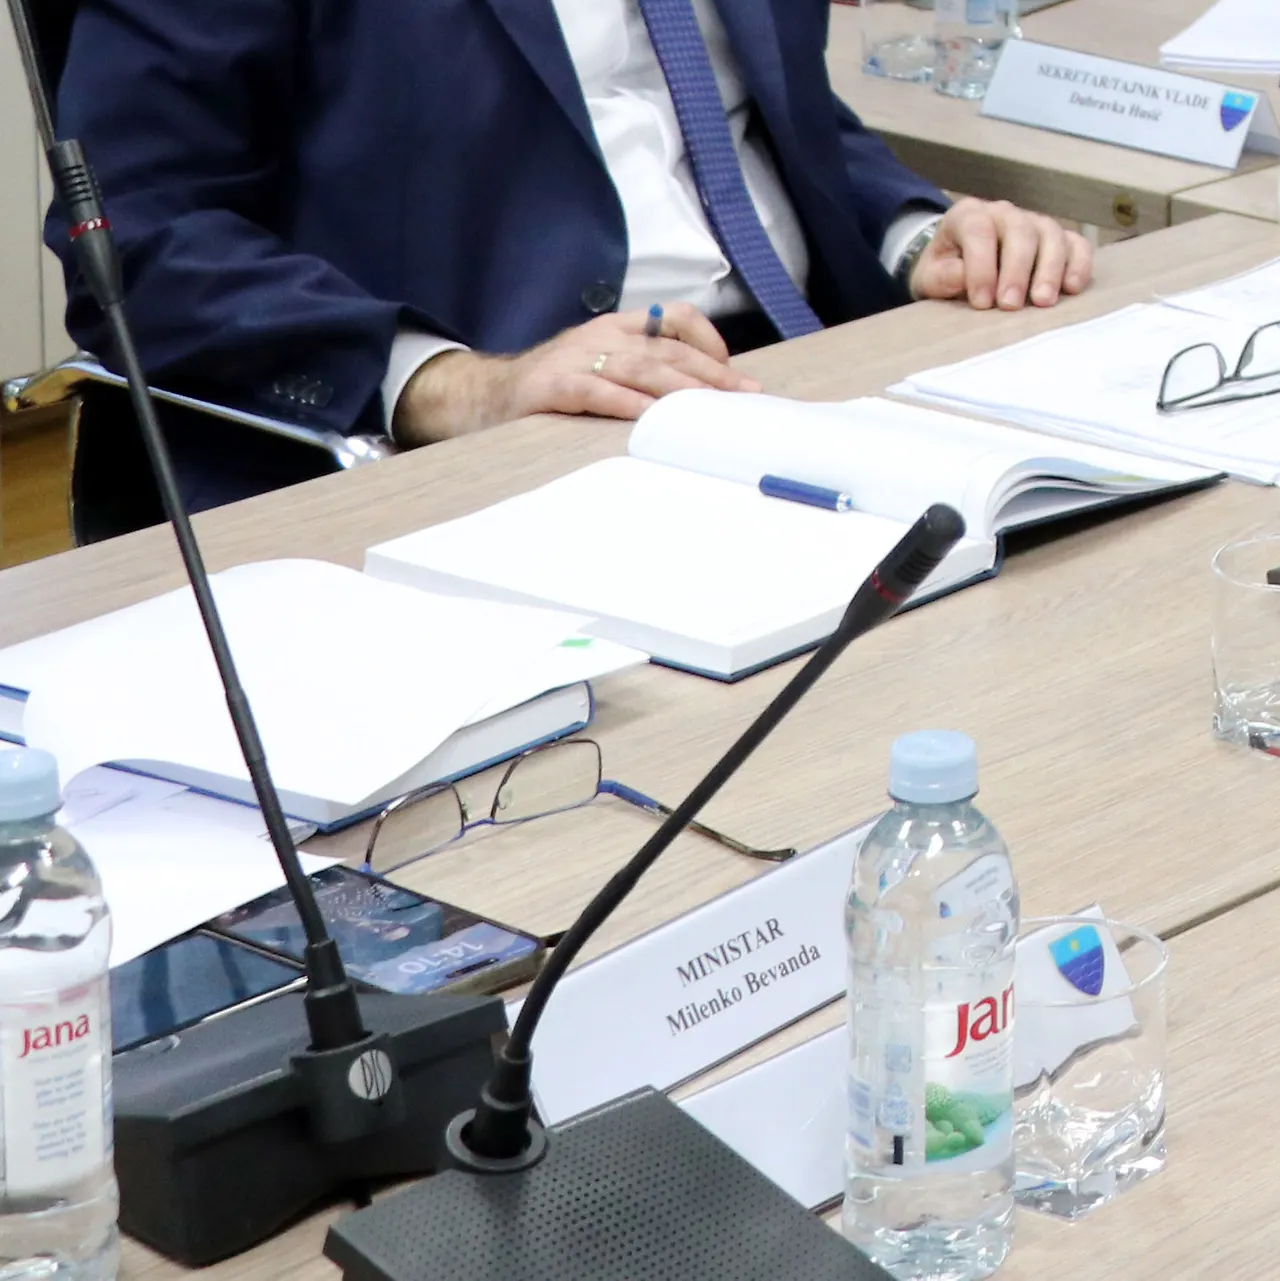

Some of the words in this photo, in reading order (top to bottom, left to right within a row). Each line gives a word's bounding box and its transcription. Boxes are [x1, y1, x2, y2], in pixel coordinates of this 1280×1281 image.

[1164, 87, 1212, 111] VLADE
[675, 917, 785, 988] MINISTAR
[665, 983, 743, 1037] Milenko
[742, 944, 822, 996] Bevanda
[944, 981, 1015, 1059] Jan
[18, 1014, 90, 1059] Jana
